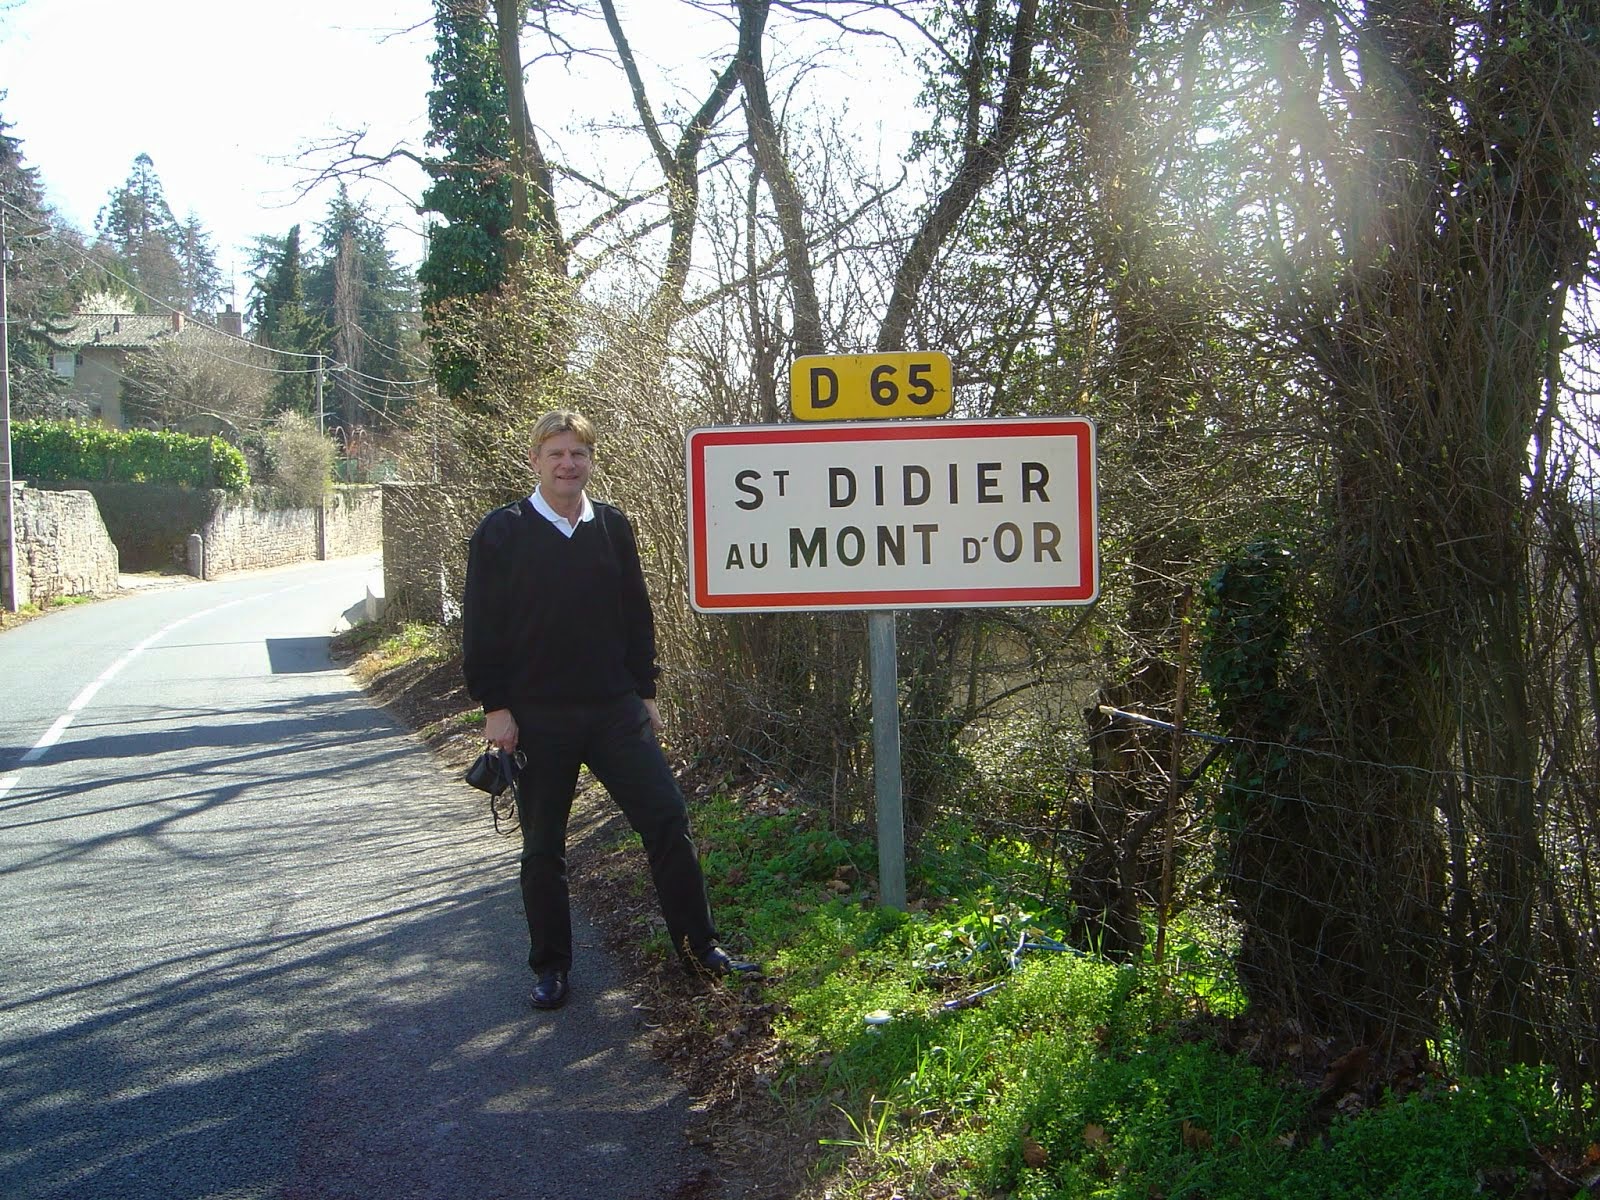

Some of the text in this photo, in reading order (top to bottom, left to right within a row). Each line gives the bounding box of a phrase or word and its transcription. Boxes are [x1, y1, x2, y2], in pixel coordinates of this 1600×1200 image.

[809, 364, 935, 409] D 65
[828, 462, 1051, 508] DIDIER
[725, 521, 1063, 570] AU MONT D'OR
